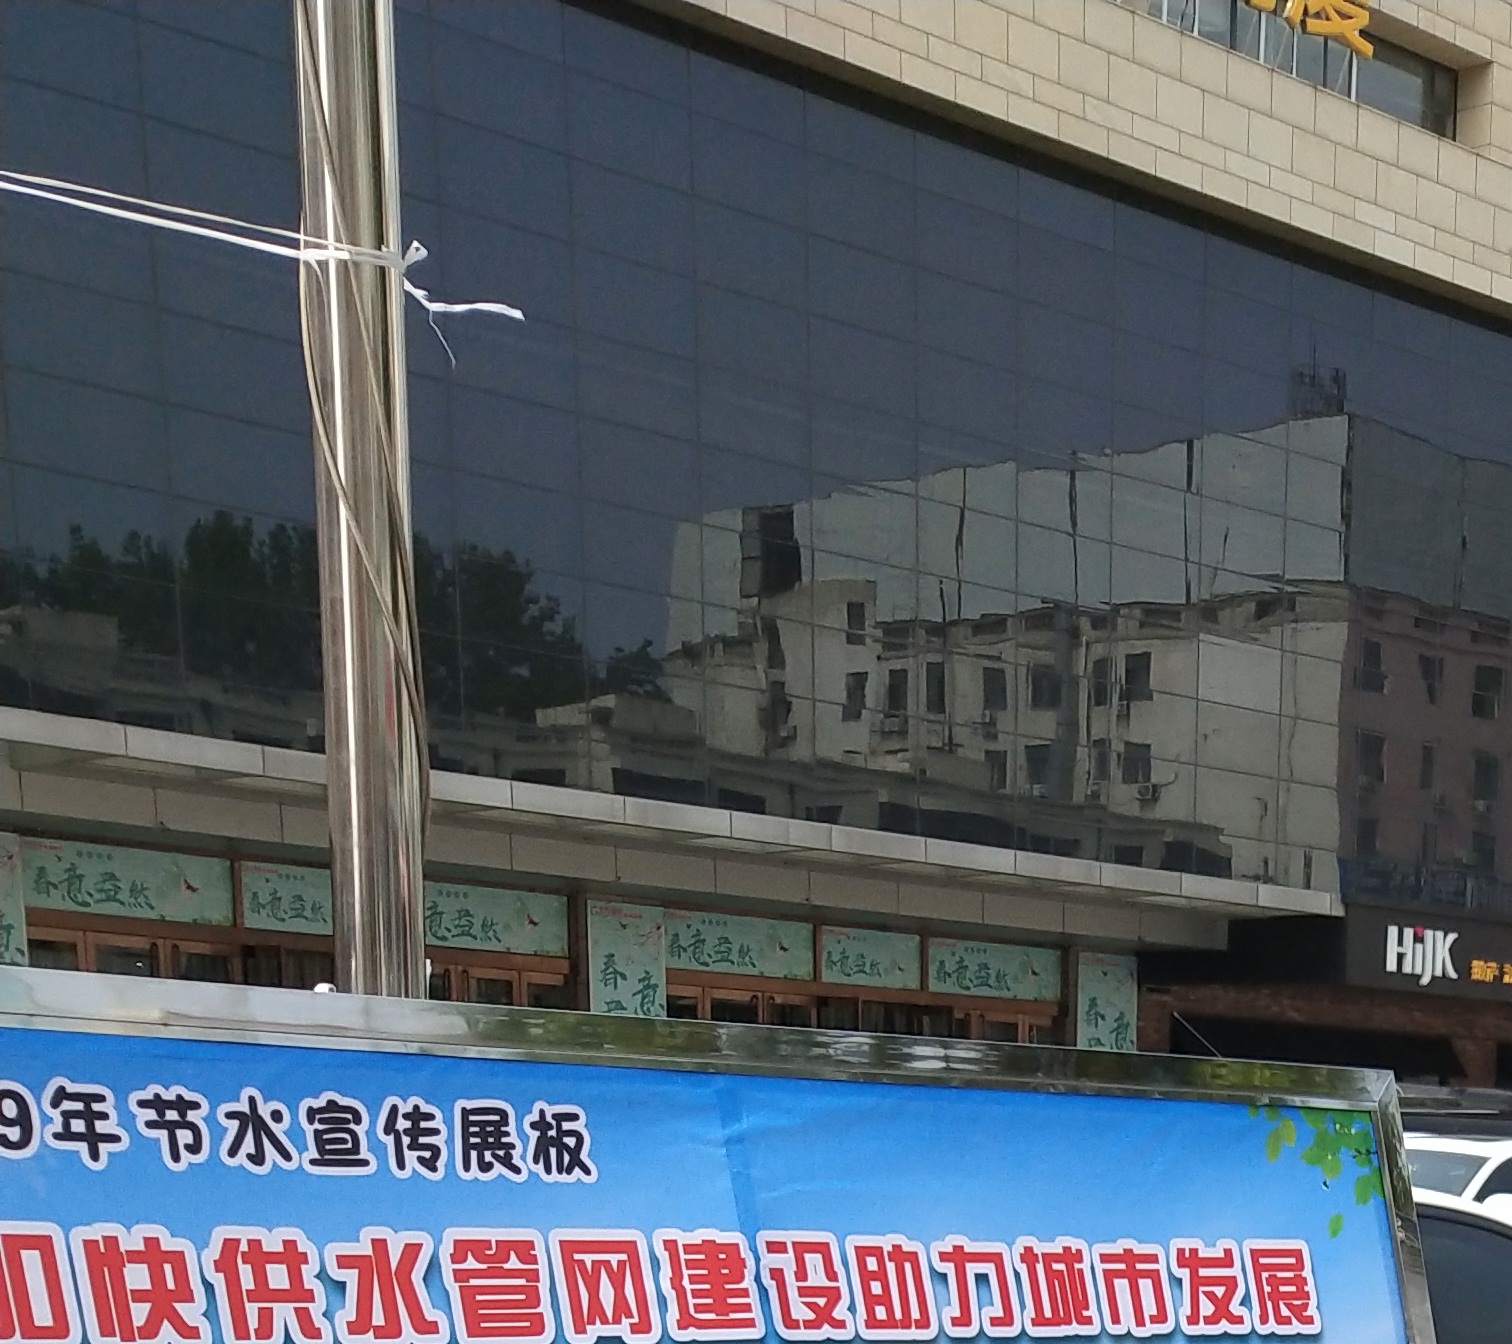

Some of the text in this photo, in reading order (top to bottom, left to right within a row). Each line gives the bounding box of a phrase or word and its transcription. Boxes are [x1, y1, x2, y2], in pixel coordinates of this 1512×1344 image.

[0, 1086, 595, 1180] 9年节水宣传展板
[0, 1232, 1315, 1344] 加快供水管网建设助力城市发展
